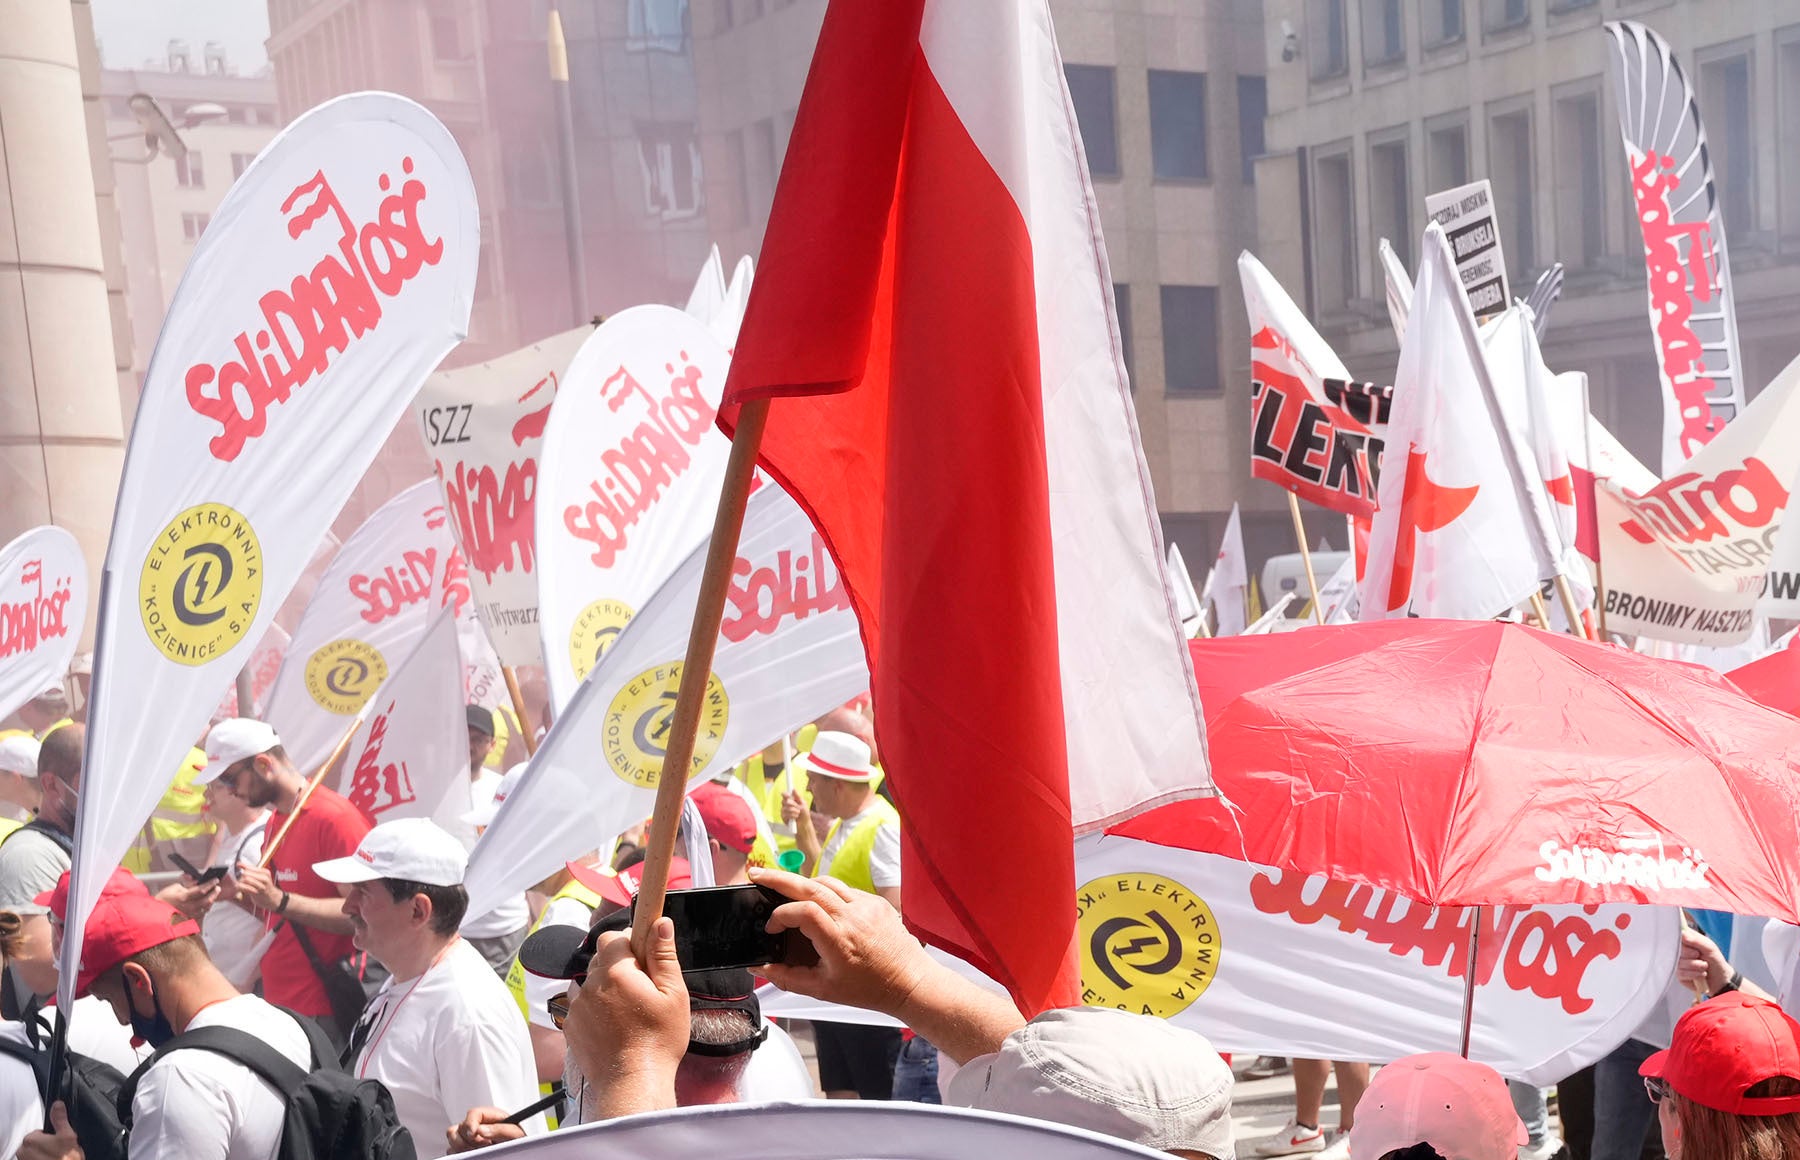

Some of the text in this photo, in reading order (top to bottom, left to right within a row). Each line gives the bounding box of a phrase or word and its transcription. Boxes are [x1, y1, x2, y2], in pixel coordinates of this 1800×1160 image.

[422, 403, 474, 446] SZZ
[150, 510, 257, 580] ELEKTROWNIA
[1605, 588, 1696, 630] BRONIMY
[1117, 880, 1213, 1000] ELEKTROWNIA
